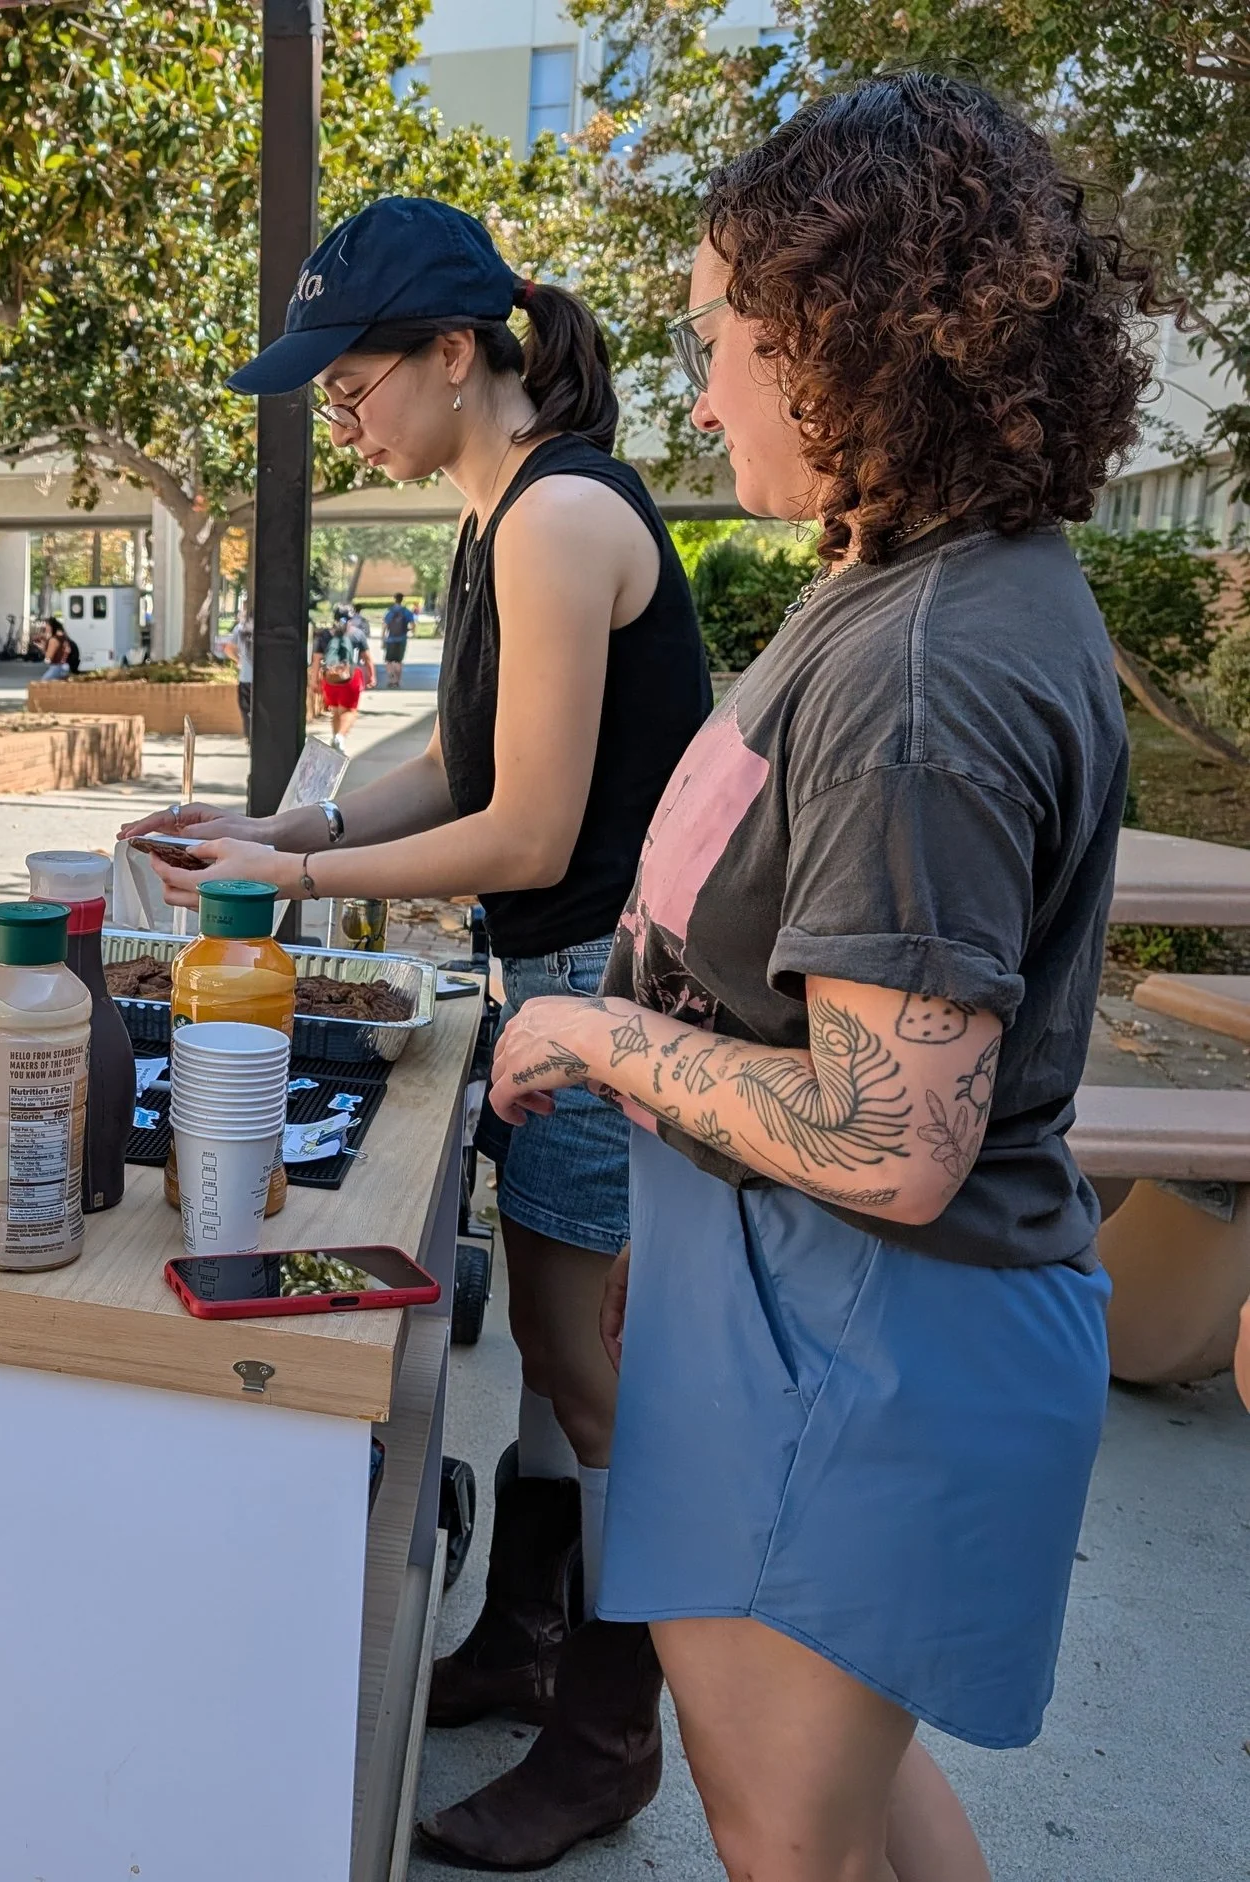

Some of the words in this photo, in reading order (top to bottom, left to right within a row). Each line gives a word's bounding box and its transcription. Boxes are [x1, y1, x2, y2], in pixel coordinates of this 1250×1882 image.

[10, 1051, 31, 1060] HELLO
[33, 1051, 52, 1059] FROM
[10, 1061, 39, 1070] MAKERS
[40, 1061, 49, 1069] OF
[51, 1059, 62, 1068] THE
[63, 1055, 81, 1067] COFFEE
[10, 1071, 24, 1079] YOU
[26, 1070, 47, 1079] KNOW
[48, 1069, 62, 1078] AND
[62, 1067, 76, 1077] LOVE
[11, 1088, 49, 1096] Nutrition
[51, 1085, 71, 1094] Facts
[53, 1108, 69, 1118] 190
